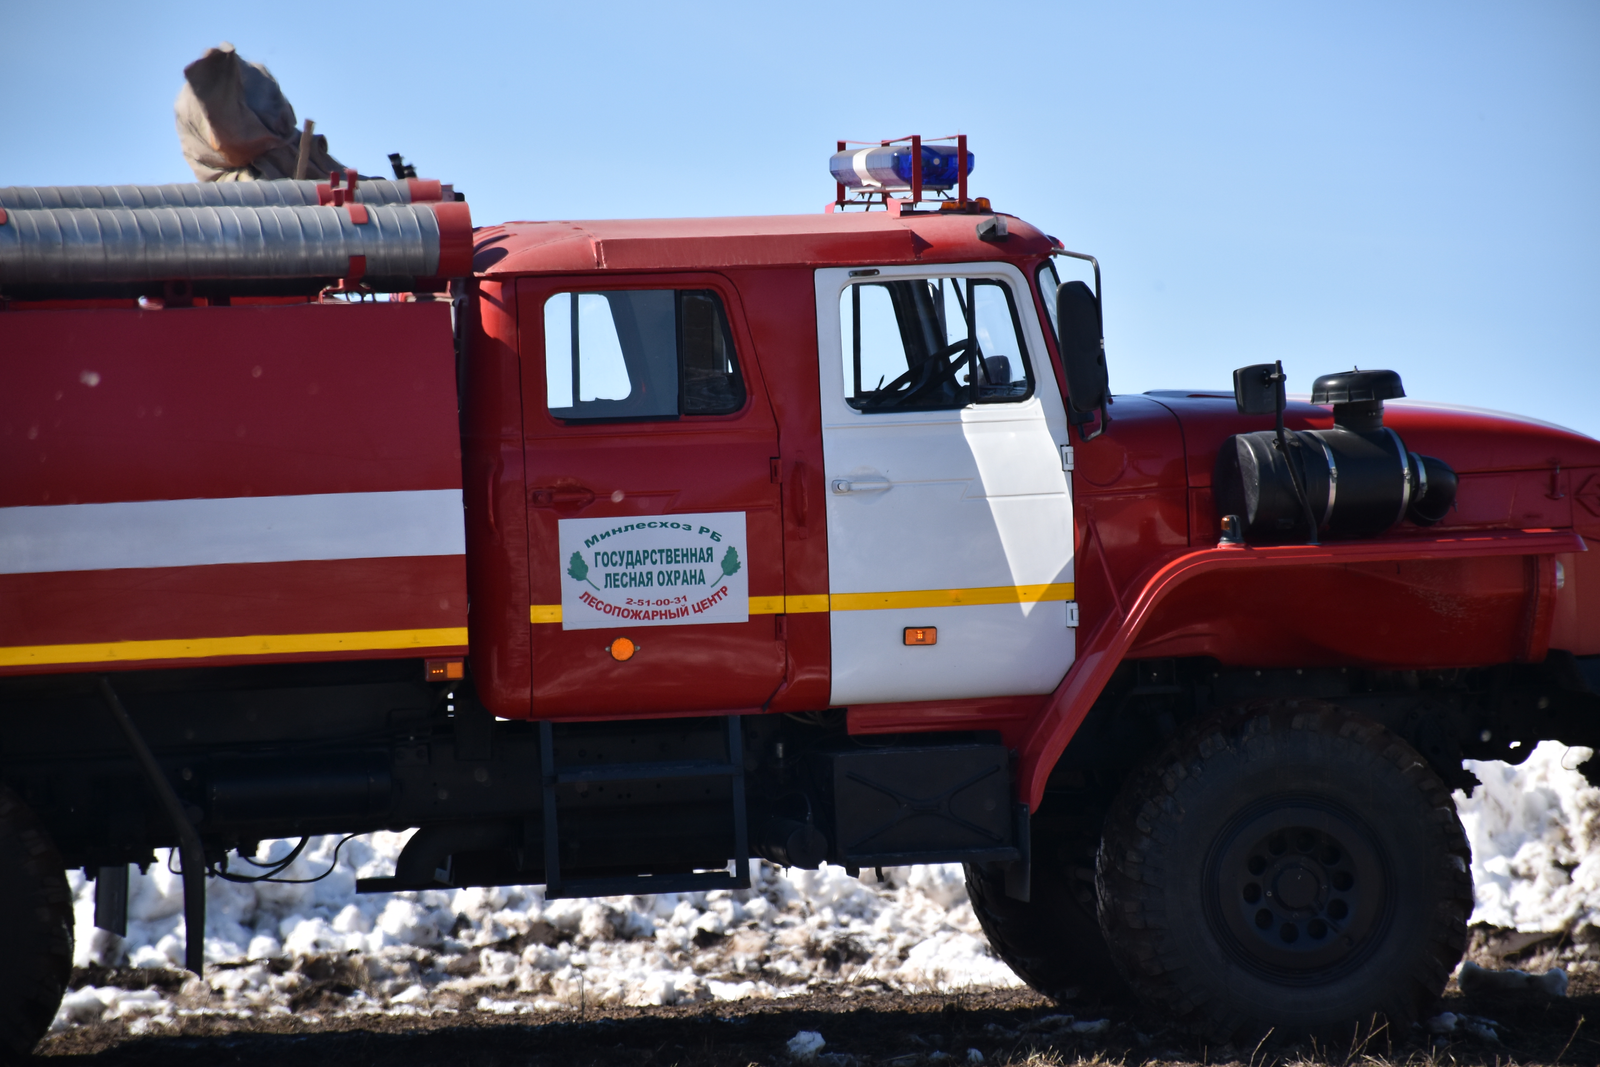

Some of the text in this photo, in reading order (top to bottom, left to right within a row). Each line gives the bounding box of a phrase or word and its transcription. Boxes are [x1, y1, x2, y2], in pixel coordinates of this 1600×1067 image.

[584, 521, 722, 548] Минлесхоз РБ
[594, 546, 714, 569] ГОСУДАРСТВЕННАЯ
[604, 569, 706, 589] ЛЕСНАЯ ОХРАНА
[579, 585, 729, 621] ЛЕСОПОЖАРНЫЙ ЦЕНТР
[625, 595, 688, 607] 2-51-00-31
